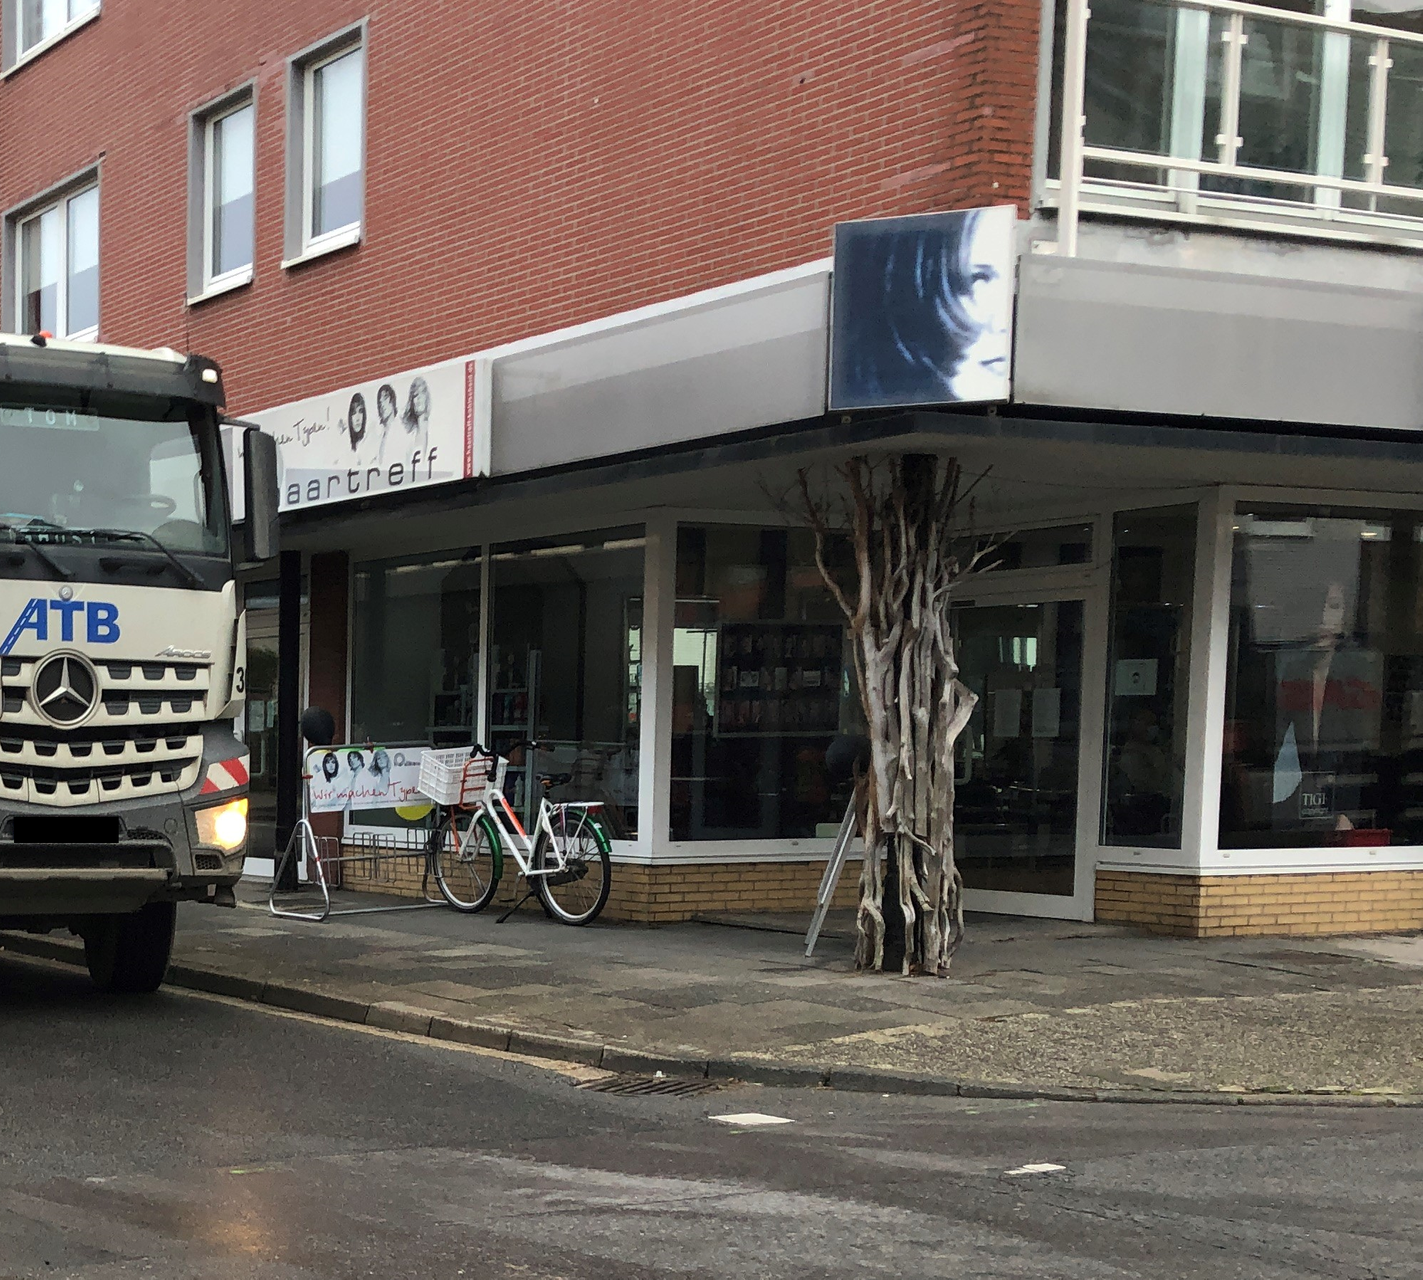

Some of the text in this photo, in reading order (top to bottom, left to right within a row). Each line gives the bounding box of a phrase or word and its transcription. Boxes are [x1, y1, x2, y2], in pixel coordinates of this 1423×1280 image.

[24, 407, 77, 426] TOM
[287, 447, 438, 505] aartreff
[235, 667, 246, 693] 3
[313, 788, 333, 800] Wir
[336, 785, 387, 800] machen
[1302, 793, 1326, 806] TIGI
